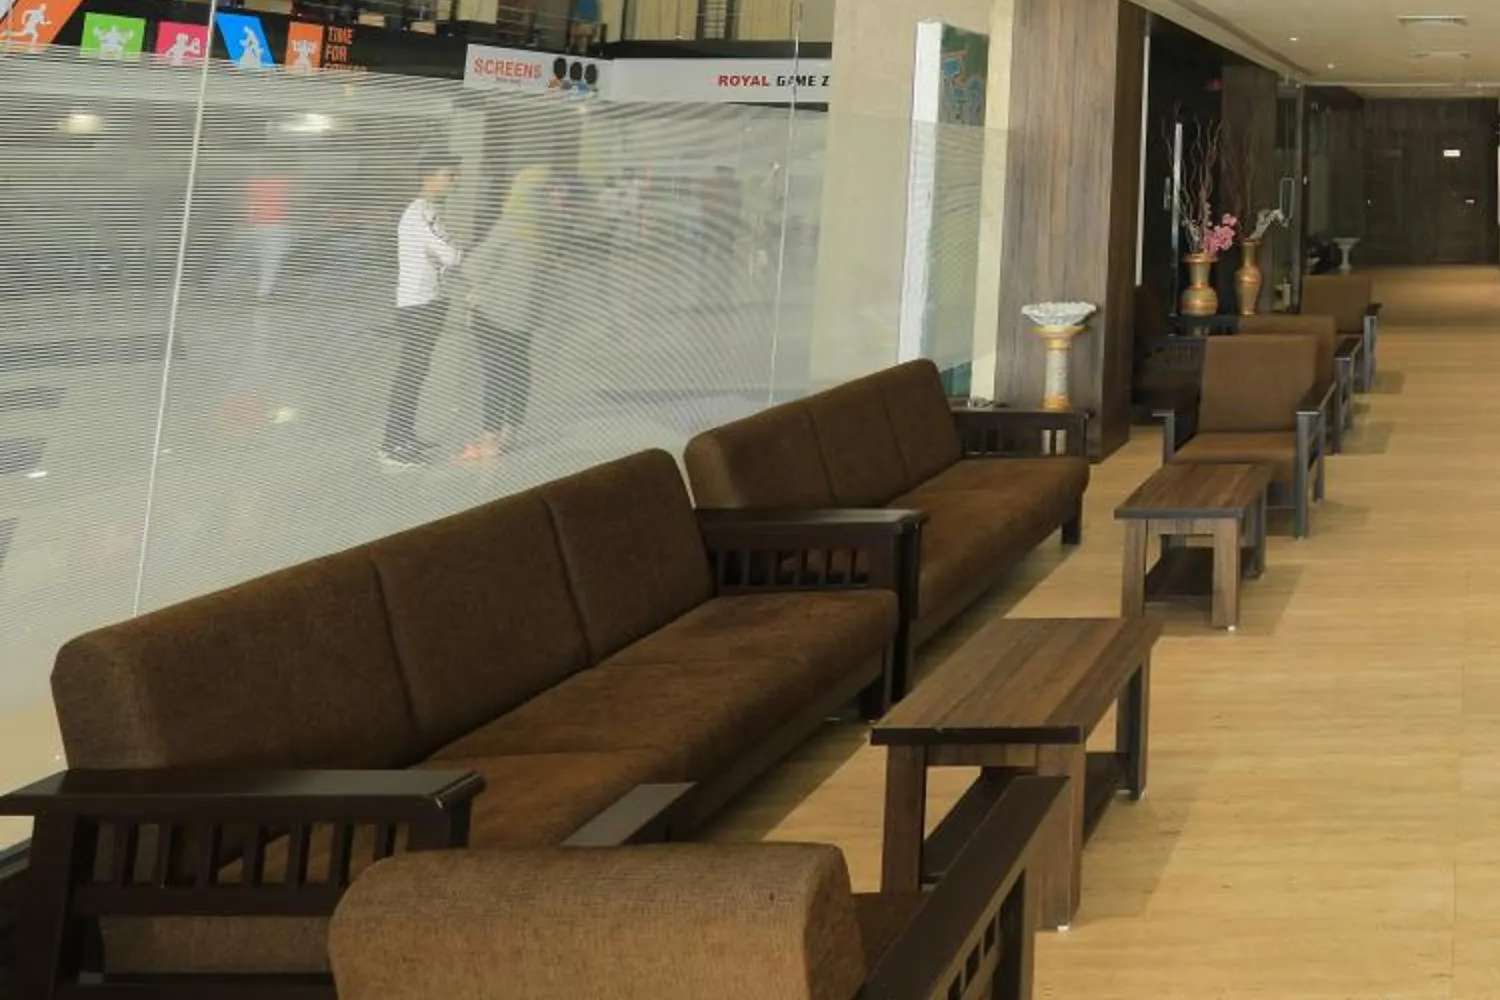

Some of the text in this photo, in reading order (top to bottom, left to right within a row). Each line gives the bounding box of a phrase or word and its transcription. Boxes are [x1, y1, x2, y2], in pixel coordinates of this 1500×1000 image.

[325, 44, 348, 62] FOR
[473, 57, 543, 79] SCREENS
[717, 75, 769, 87] ROYAL
